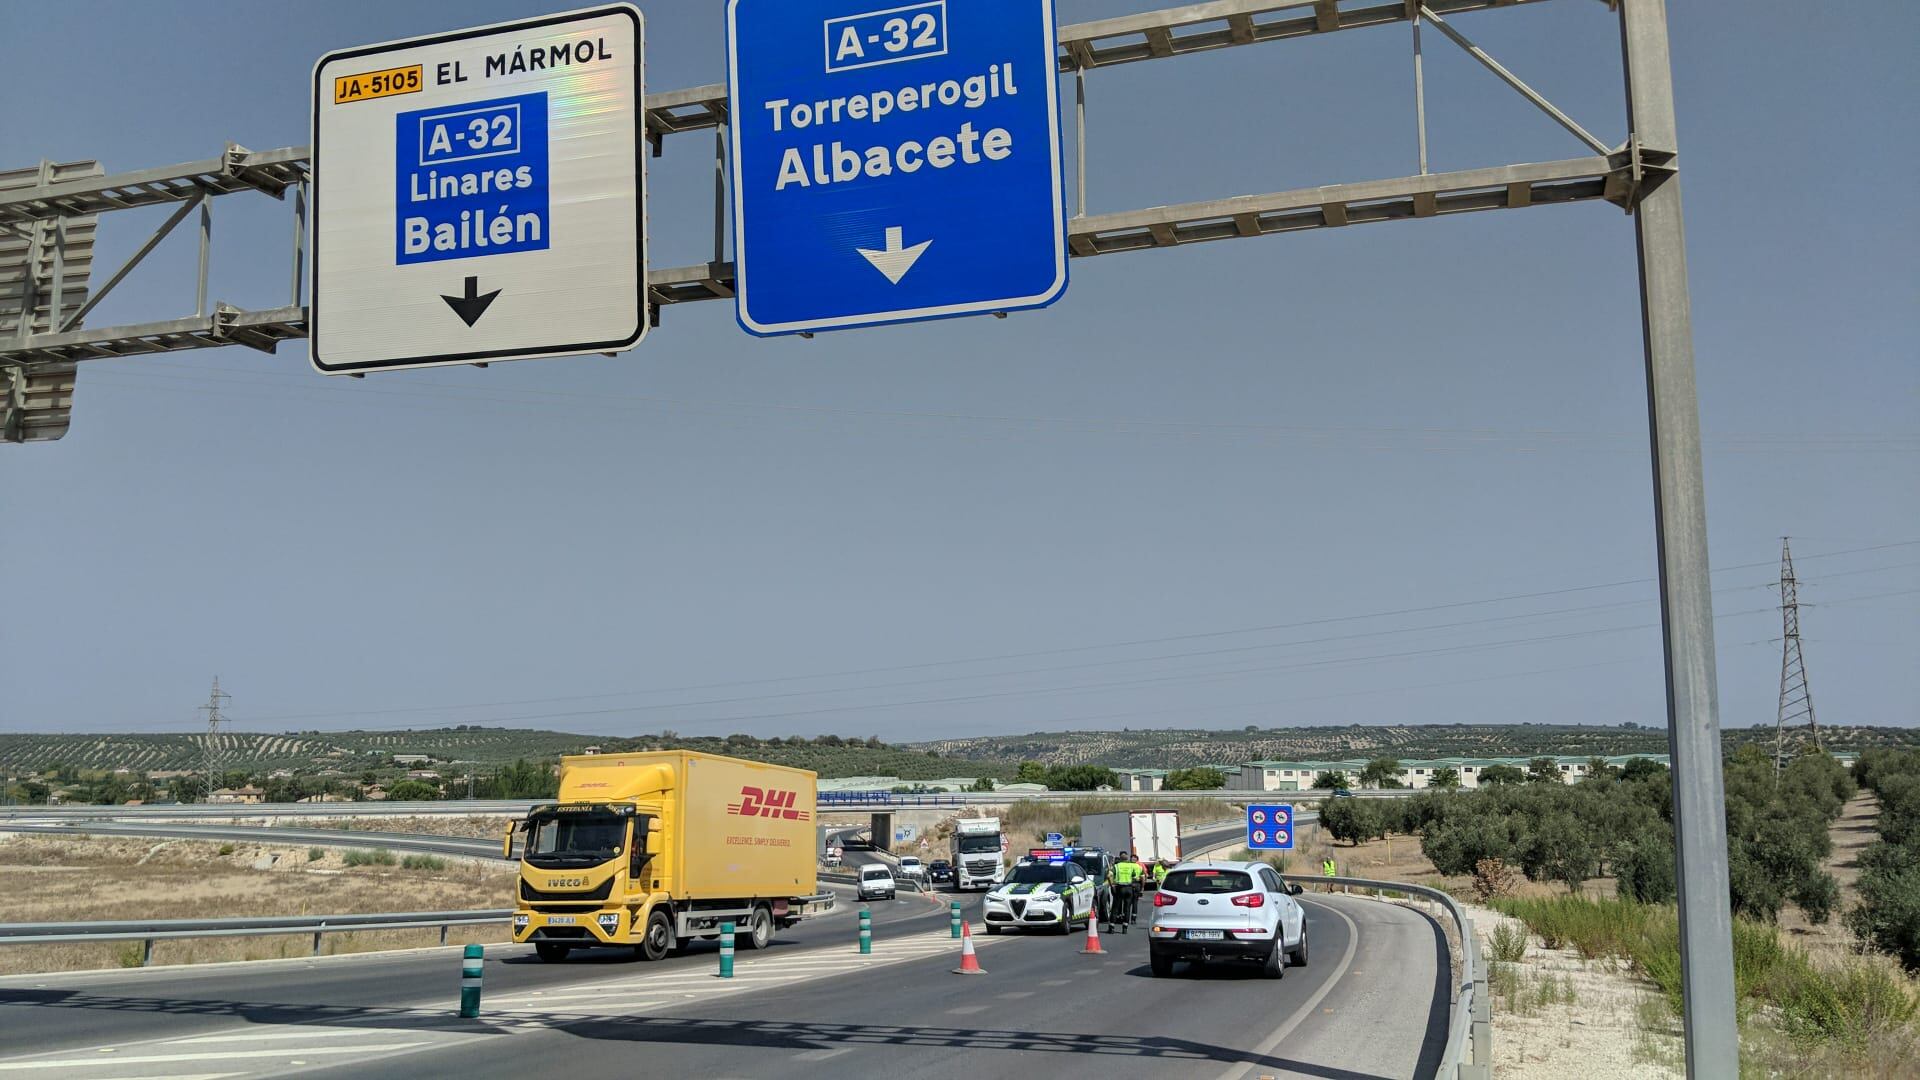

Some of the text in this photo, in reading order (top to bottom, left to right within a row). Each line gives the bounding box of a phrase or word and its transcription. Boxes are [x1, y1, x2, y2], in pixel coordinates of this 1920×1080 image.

[836, 13, 937, 61] A-32
[437, 37, 612, 85] EL MÁRMOL
[340, 70, 418, 99] JA-5105
[765, 62, 1017, 132] Torreperogil
[428, 115, 512, 155] A-32
[775, 121, 1012, 191] Albacete
[411, 164, 533, 202] Linares
[404, 205, 541, 255] Bailén
[740, 786, 799, 820] DHL
[547, 879, 580, 887] IVECO
